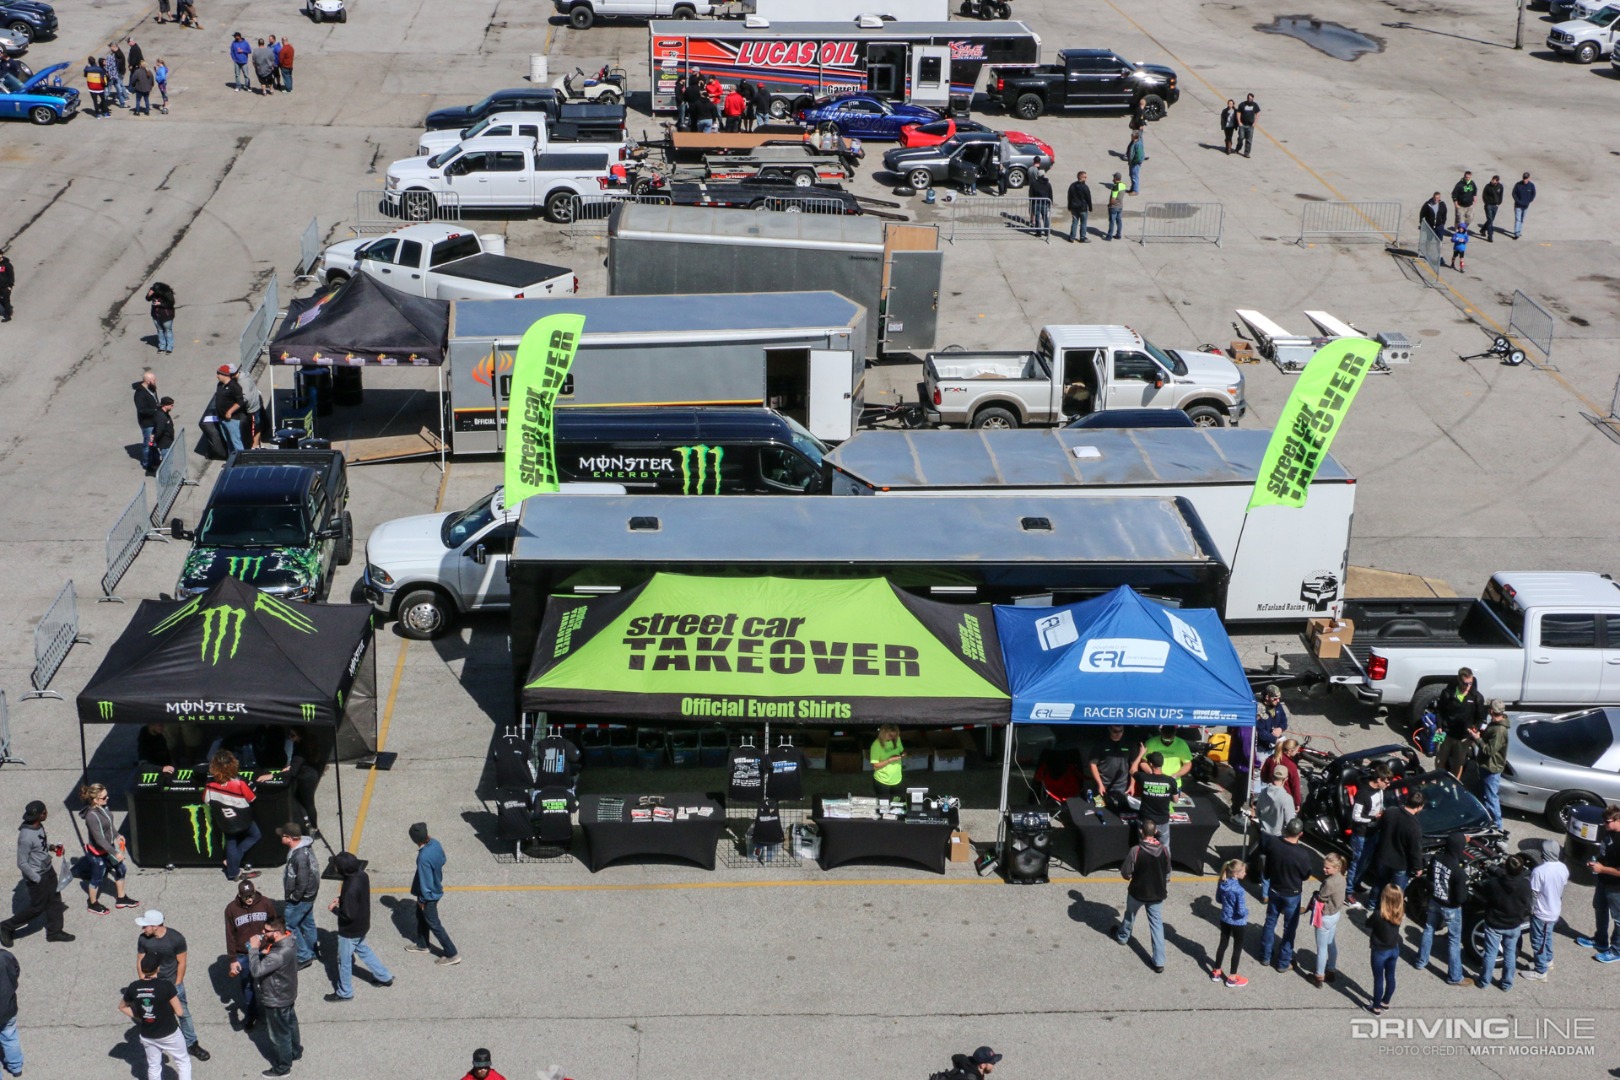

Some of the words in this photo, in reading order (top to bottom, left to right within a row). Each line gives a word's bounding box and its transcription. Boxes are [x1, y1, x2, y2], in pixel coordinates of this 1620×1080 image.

[735, 41, 817, 67] LUCAS
[817, 41, 859, 66] OIL
[826, 84, 861, 96] Garrett
[524, 386, 542, 423] car
[1278, 352, 1366, 500] TAKEOVER
[520, 424, 539, 487] street
[1266, 435, 1299, 498] street
[1291, 401, 1315, 439] car
[578, 454, 675, 472] MONSTER
[1286, 603, 1306, 612] Racing
[626, 612, 740, 637] street
[742, 616, 806, 639] car
[622, 637, 920, 677] TAKEOVER
[166, 699, 248, 715] MONSTER
[681, 697, 745, 718] Official
[748, 699, 796, 718] Event
[798, 700, 852, 719] Shirts
[1084, 707, 1124, 718] RACER
[1127, 707, 1163, 718] SIGN
[1164, 708, 1184, 719] UPS
